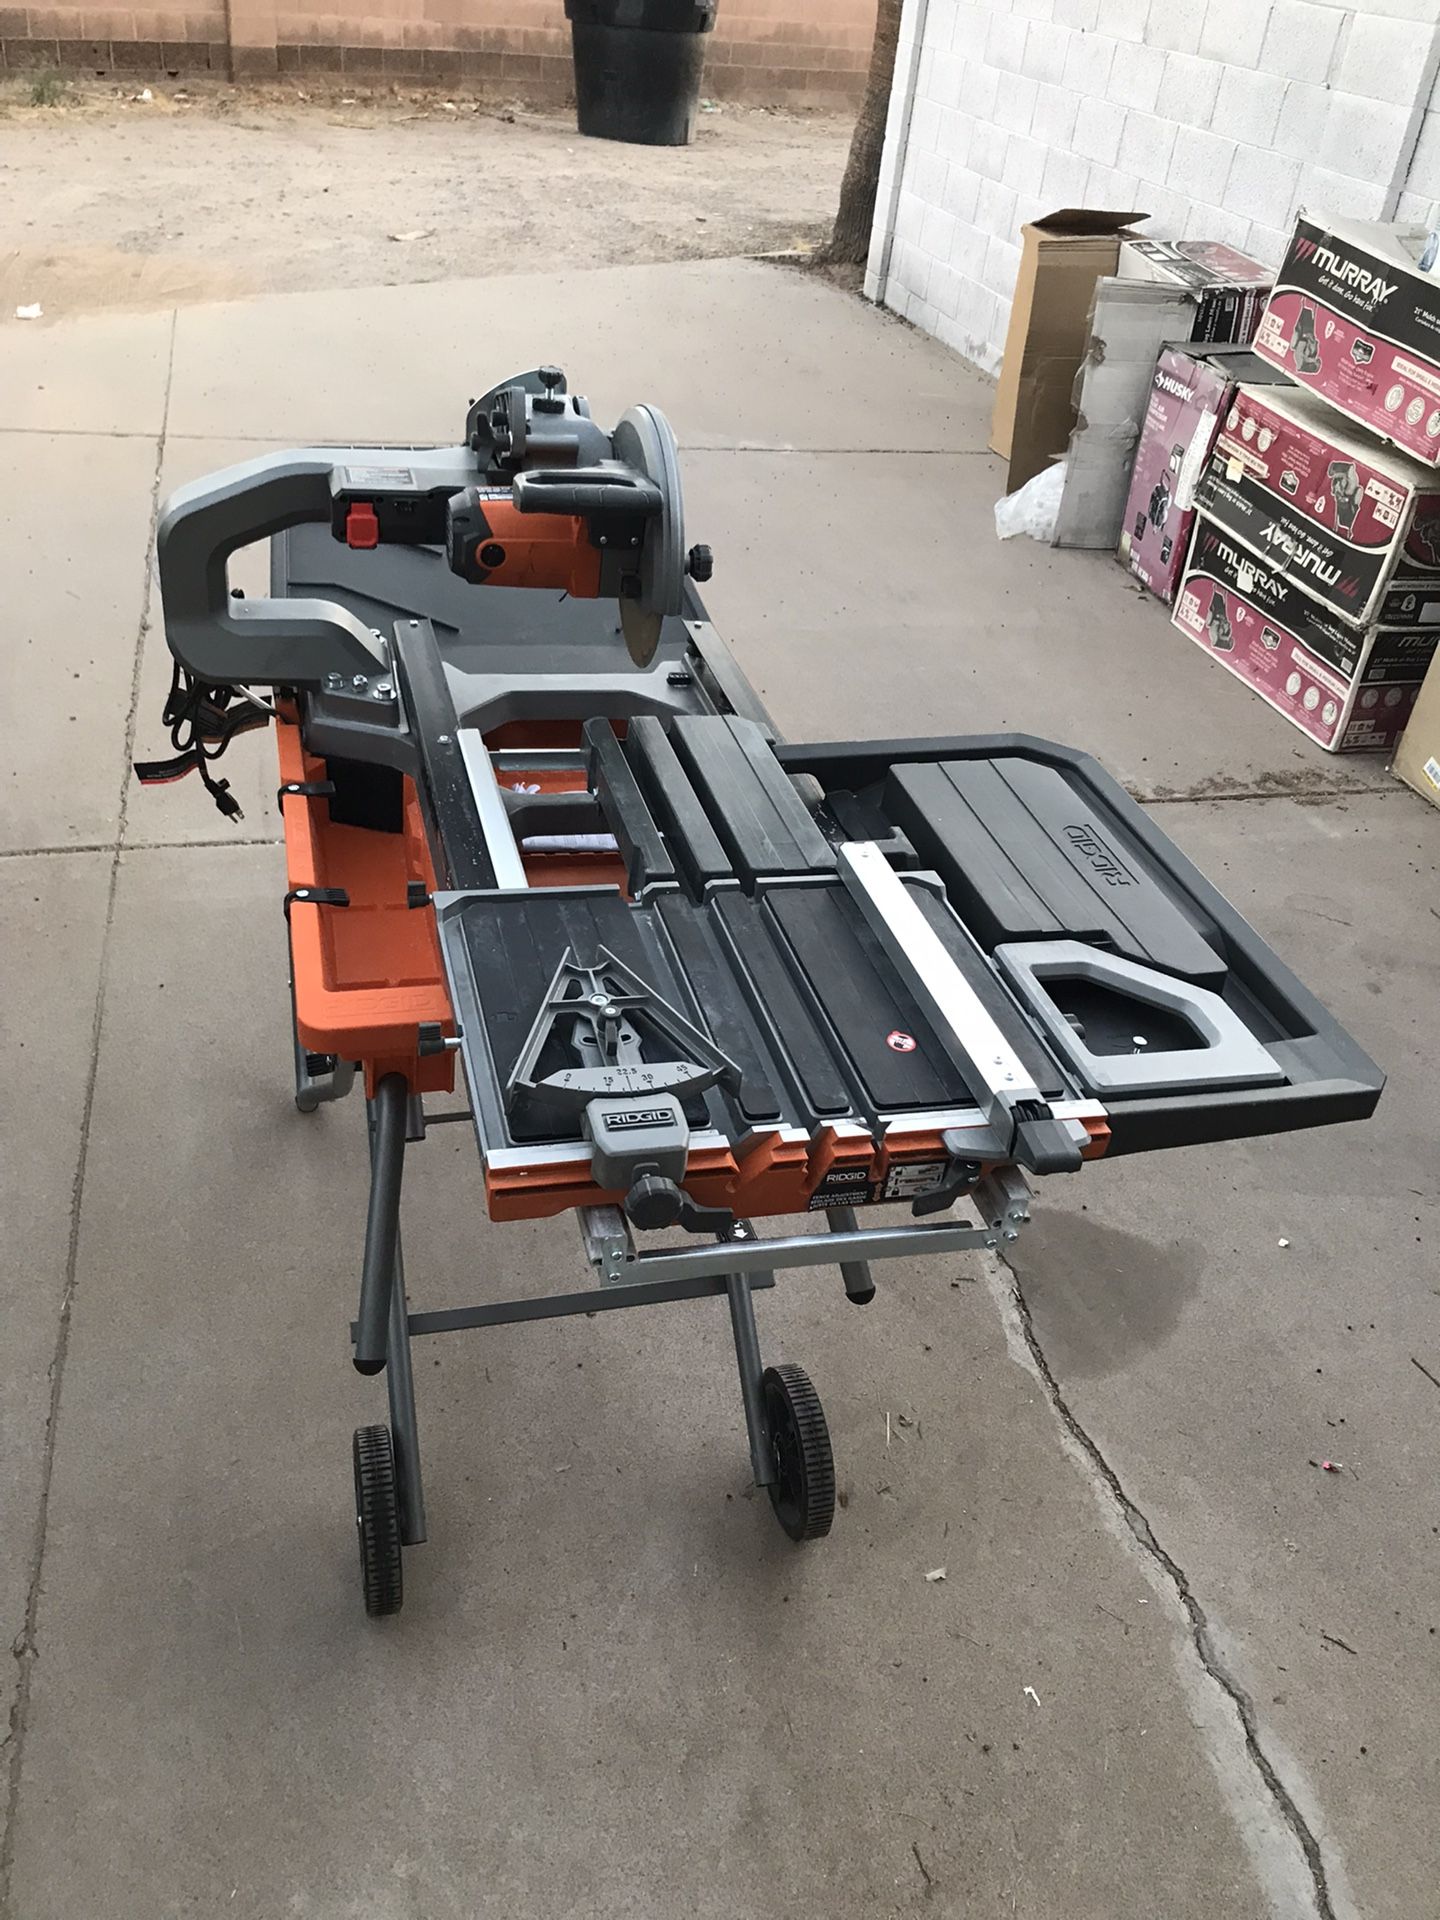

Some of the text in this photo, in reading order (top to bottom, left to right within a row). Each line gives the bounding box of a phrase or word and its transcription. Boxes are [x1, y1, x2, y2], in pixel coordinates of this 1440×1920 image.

[1311, 246, 1399, 303] MURRAY
[1162, 376, 1195, 402] HUSKY
[1217, 542, 1289, 600] MURRAY
[1259, 523, 1342, 586] MURRAY
[1063, 825, 1131, 886] RIDGID
[607, 1109, 673, 1125] RIDGID
[826, 1171, 866, 1183] RIDGID
